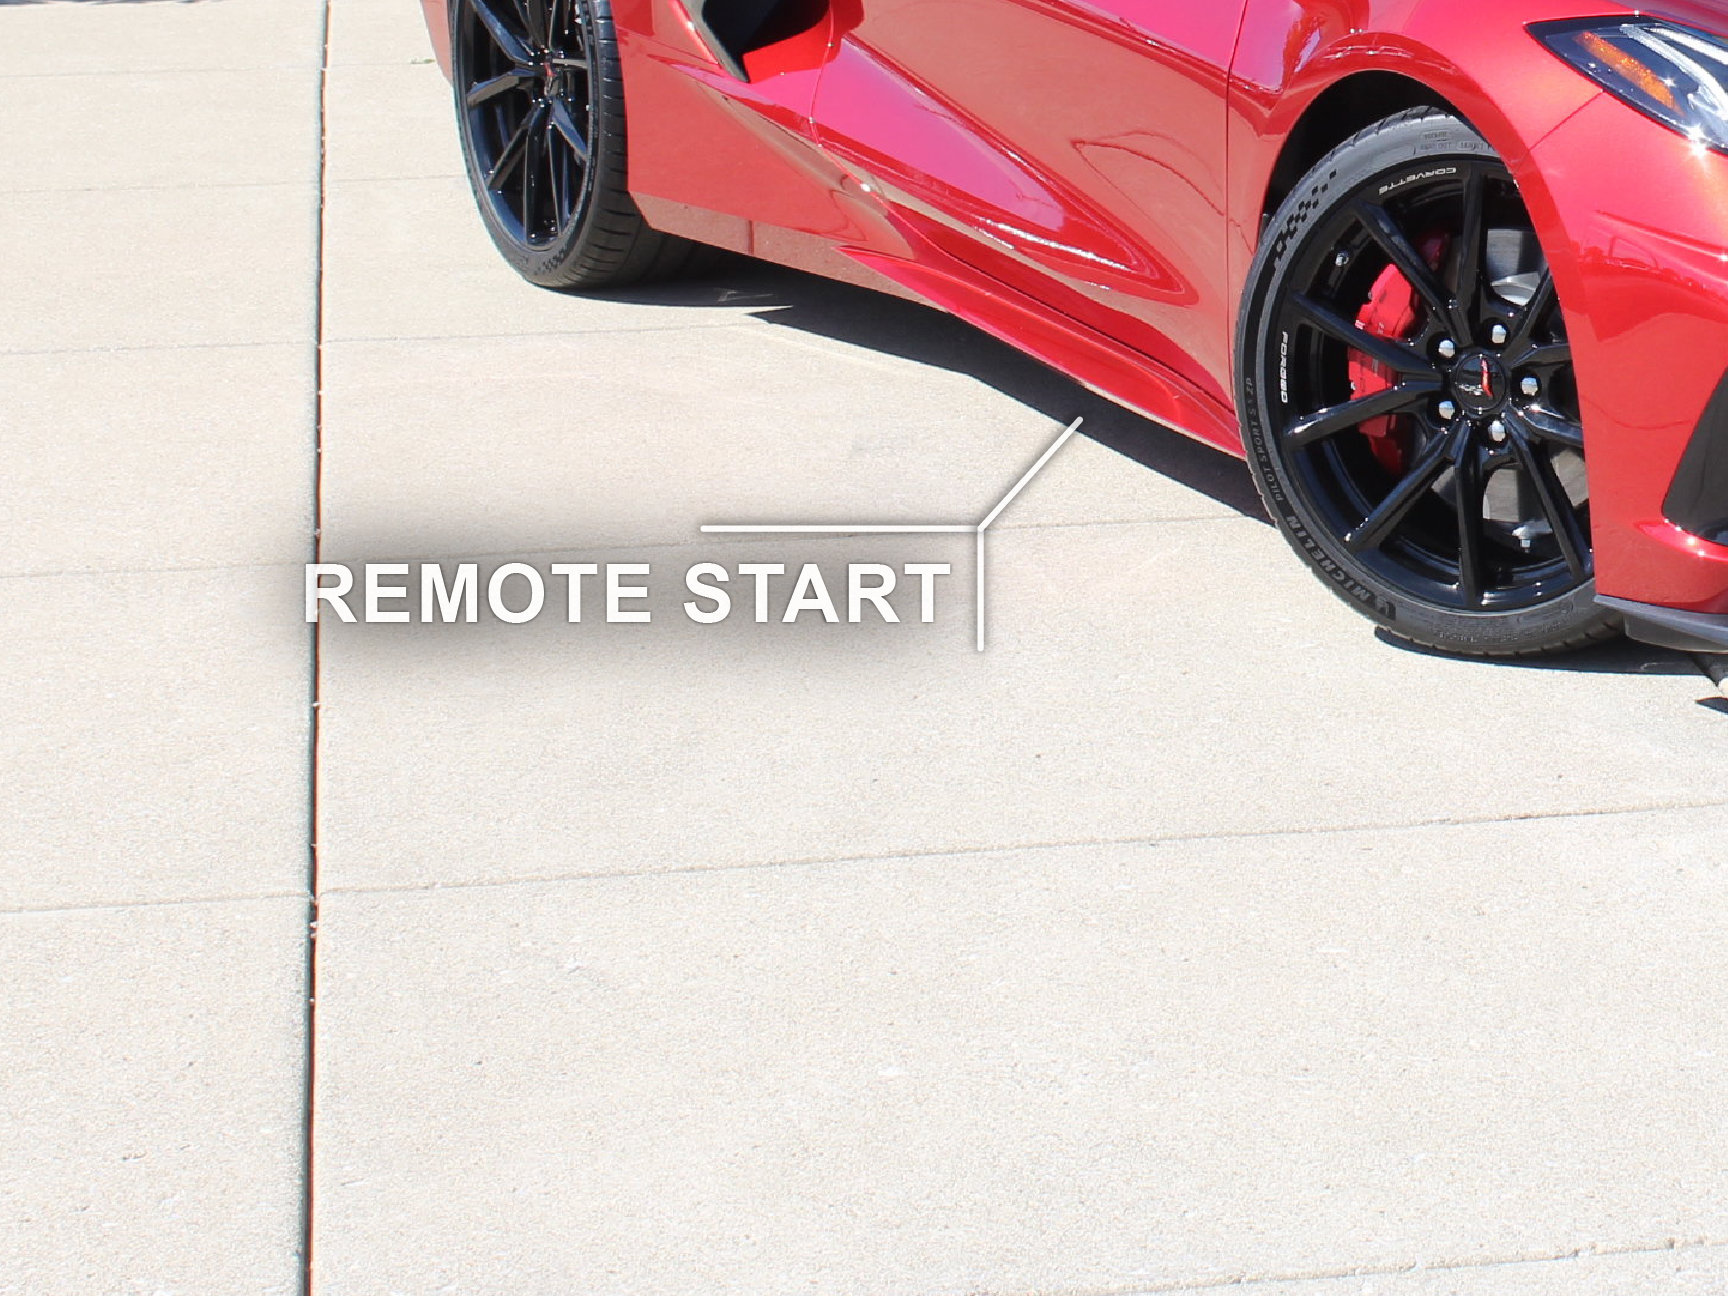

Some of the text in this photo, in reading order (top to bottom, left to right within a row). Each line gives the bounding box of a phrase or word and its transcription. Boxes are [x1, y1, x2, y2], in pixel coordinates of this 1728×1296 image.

[1378, 166, 1457, 196] CORVETTE
[1279, 330, 1289, 404] FORGED
[1263, 467, 1284, 501] PILOT
[1286, 514, 1371, 603] MICHELIN
